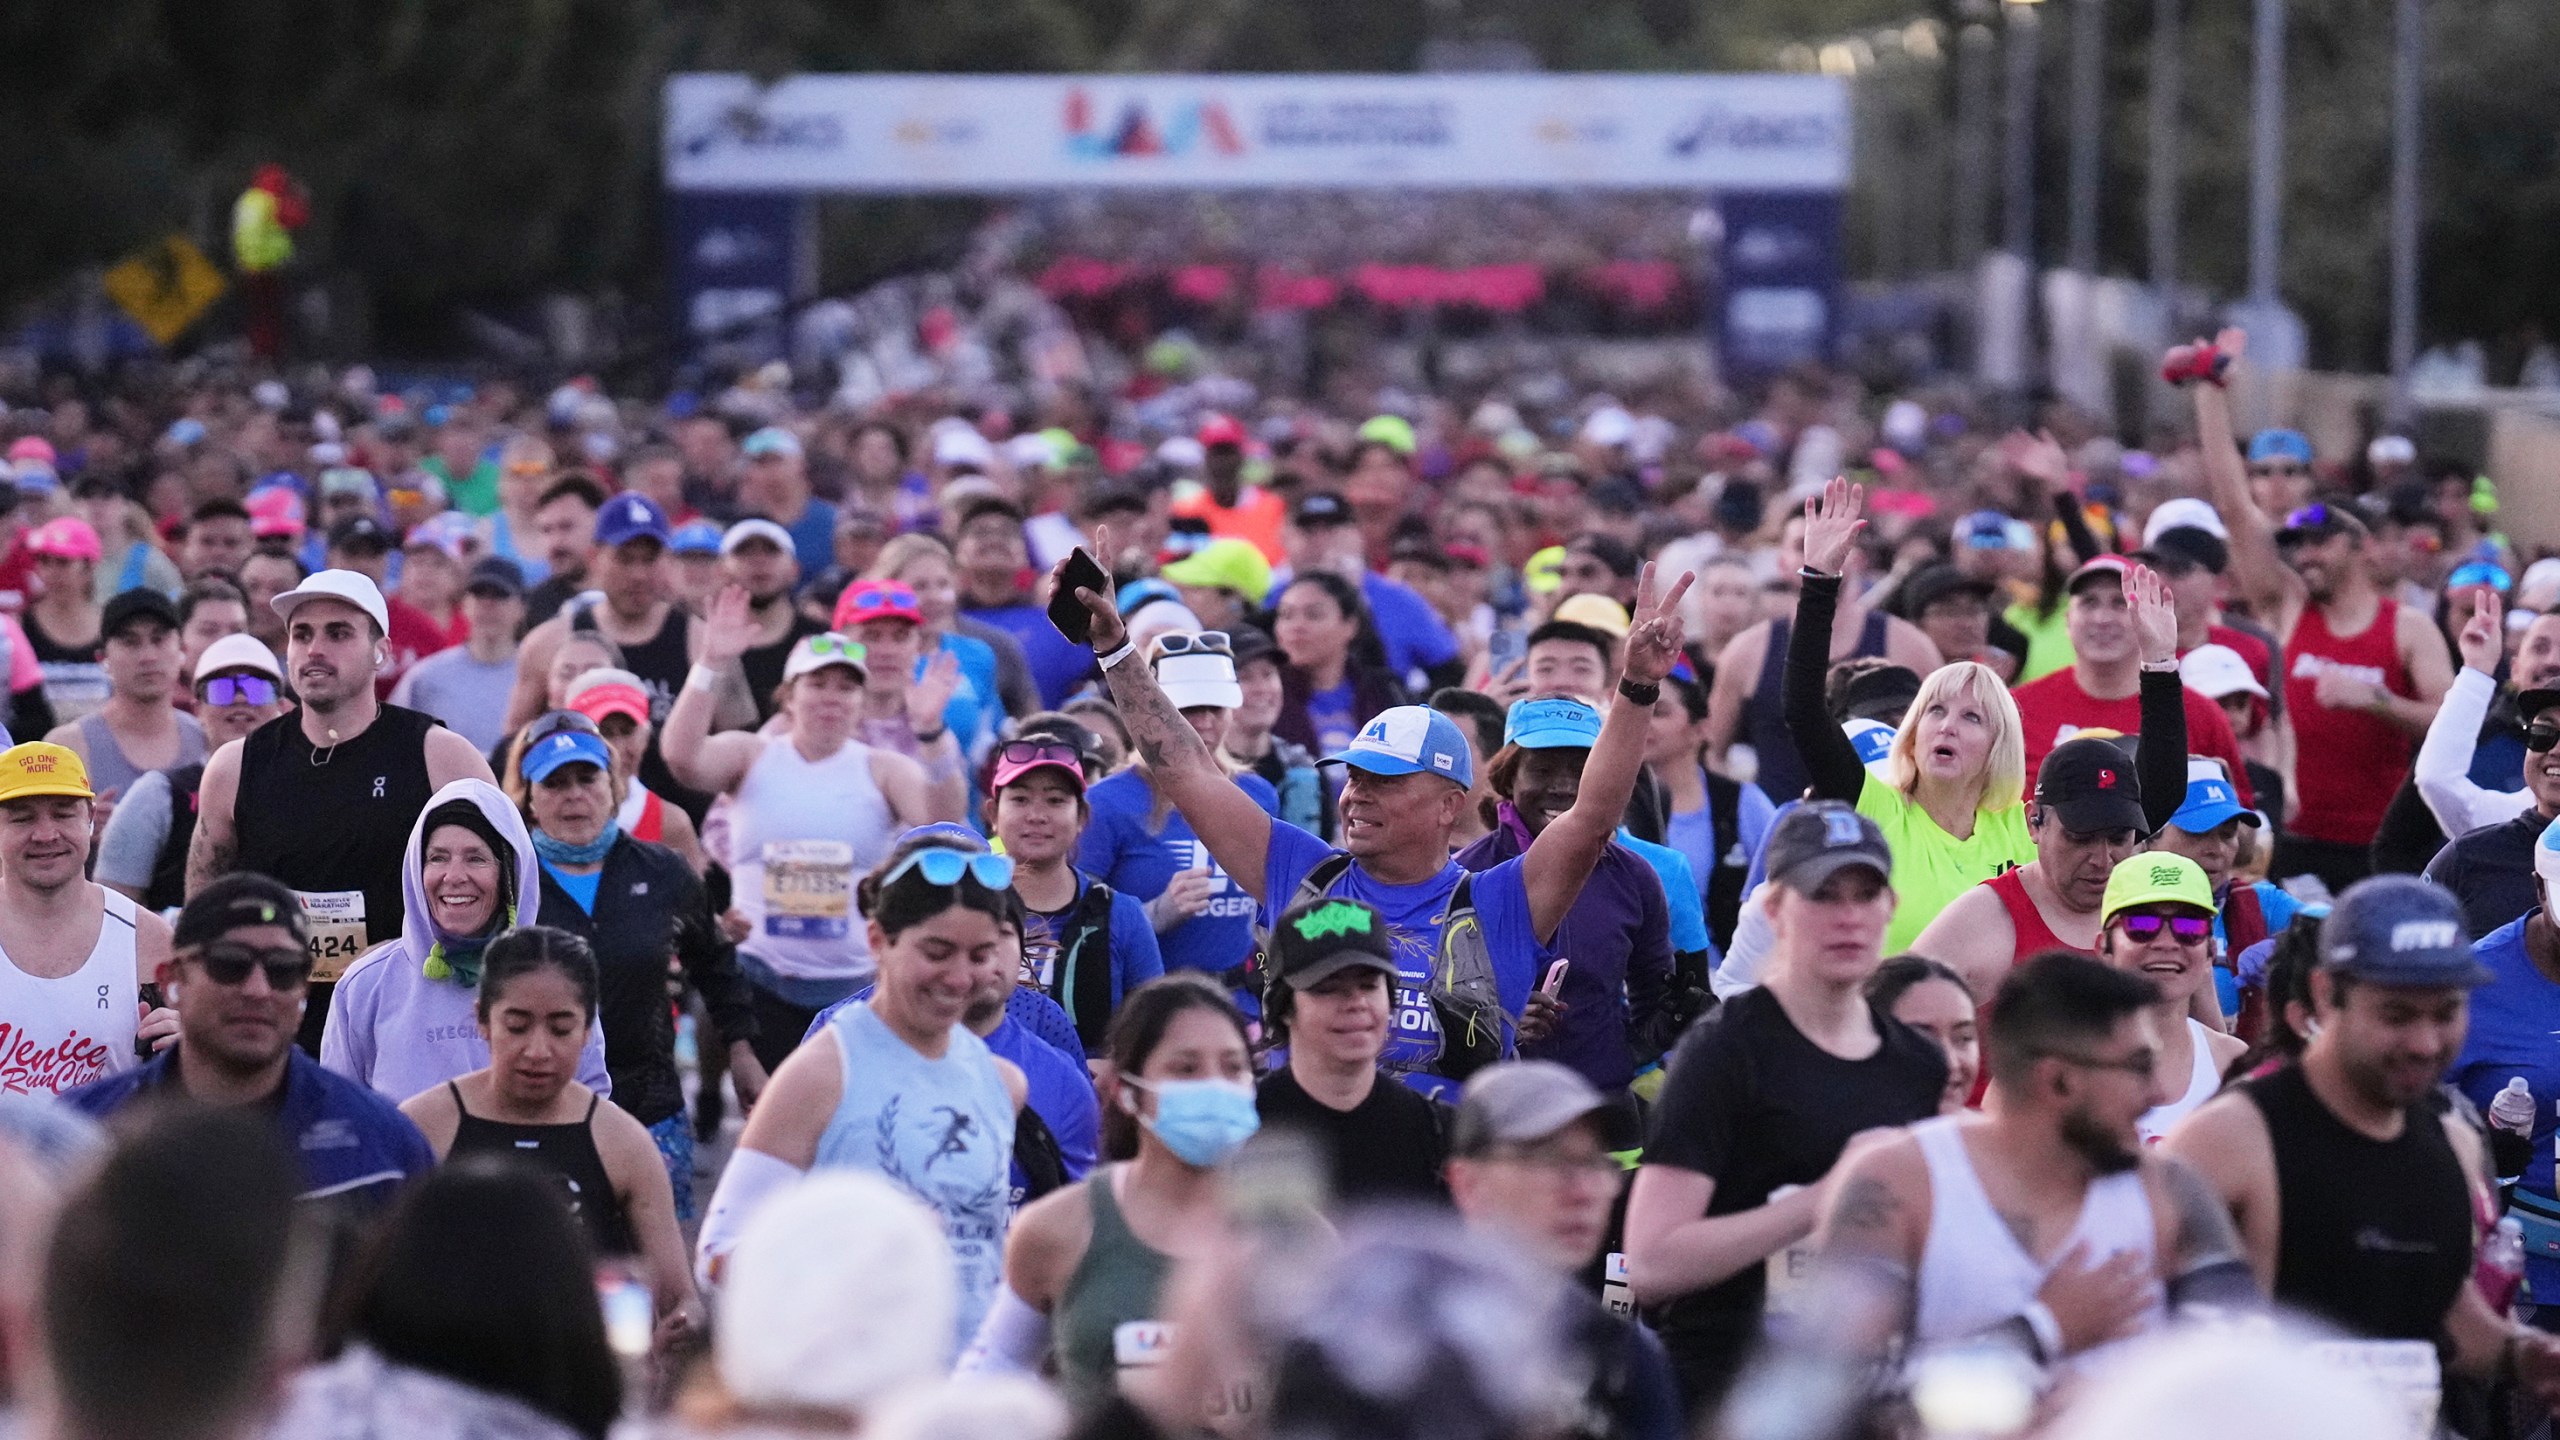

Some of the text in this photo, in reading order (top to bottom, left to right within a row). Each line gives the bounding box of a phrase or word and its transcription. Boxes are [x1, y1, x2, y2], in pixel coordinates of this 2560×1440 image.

[19, 754, 58, 767] GO ONE
[26, 763, 55, 774] MORE
[0, 1022, 108, 1073] Venice
